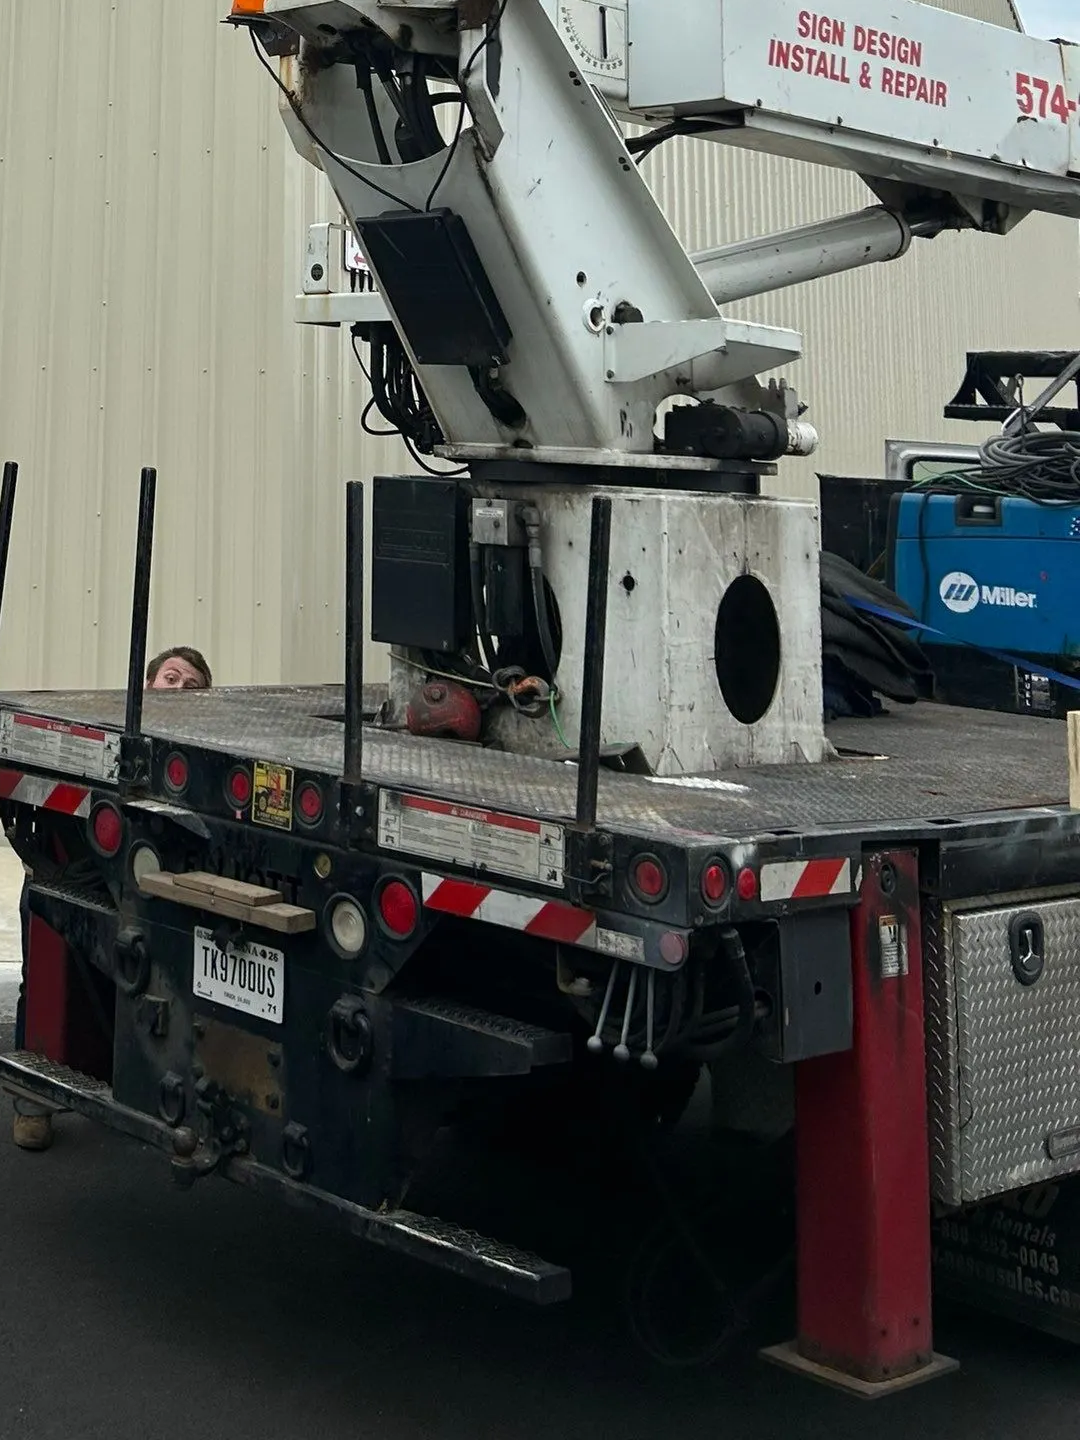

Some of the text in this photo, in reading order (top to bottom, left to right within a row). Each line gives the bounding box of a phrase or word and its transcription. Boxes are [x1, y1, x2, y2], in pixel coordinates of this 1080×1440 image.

[798, 10, 922, 67] SIGN DESIGN
[768, 39, 948, 107] INSTALL & REPAIR
[1016, 72, 1080, 125] 574-
[982, 585, 1037, 608] Miller
[202, 945, 275, 999] TK970DUS
[267, 1003, 277, 1014] 71
